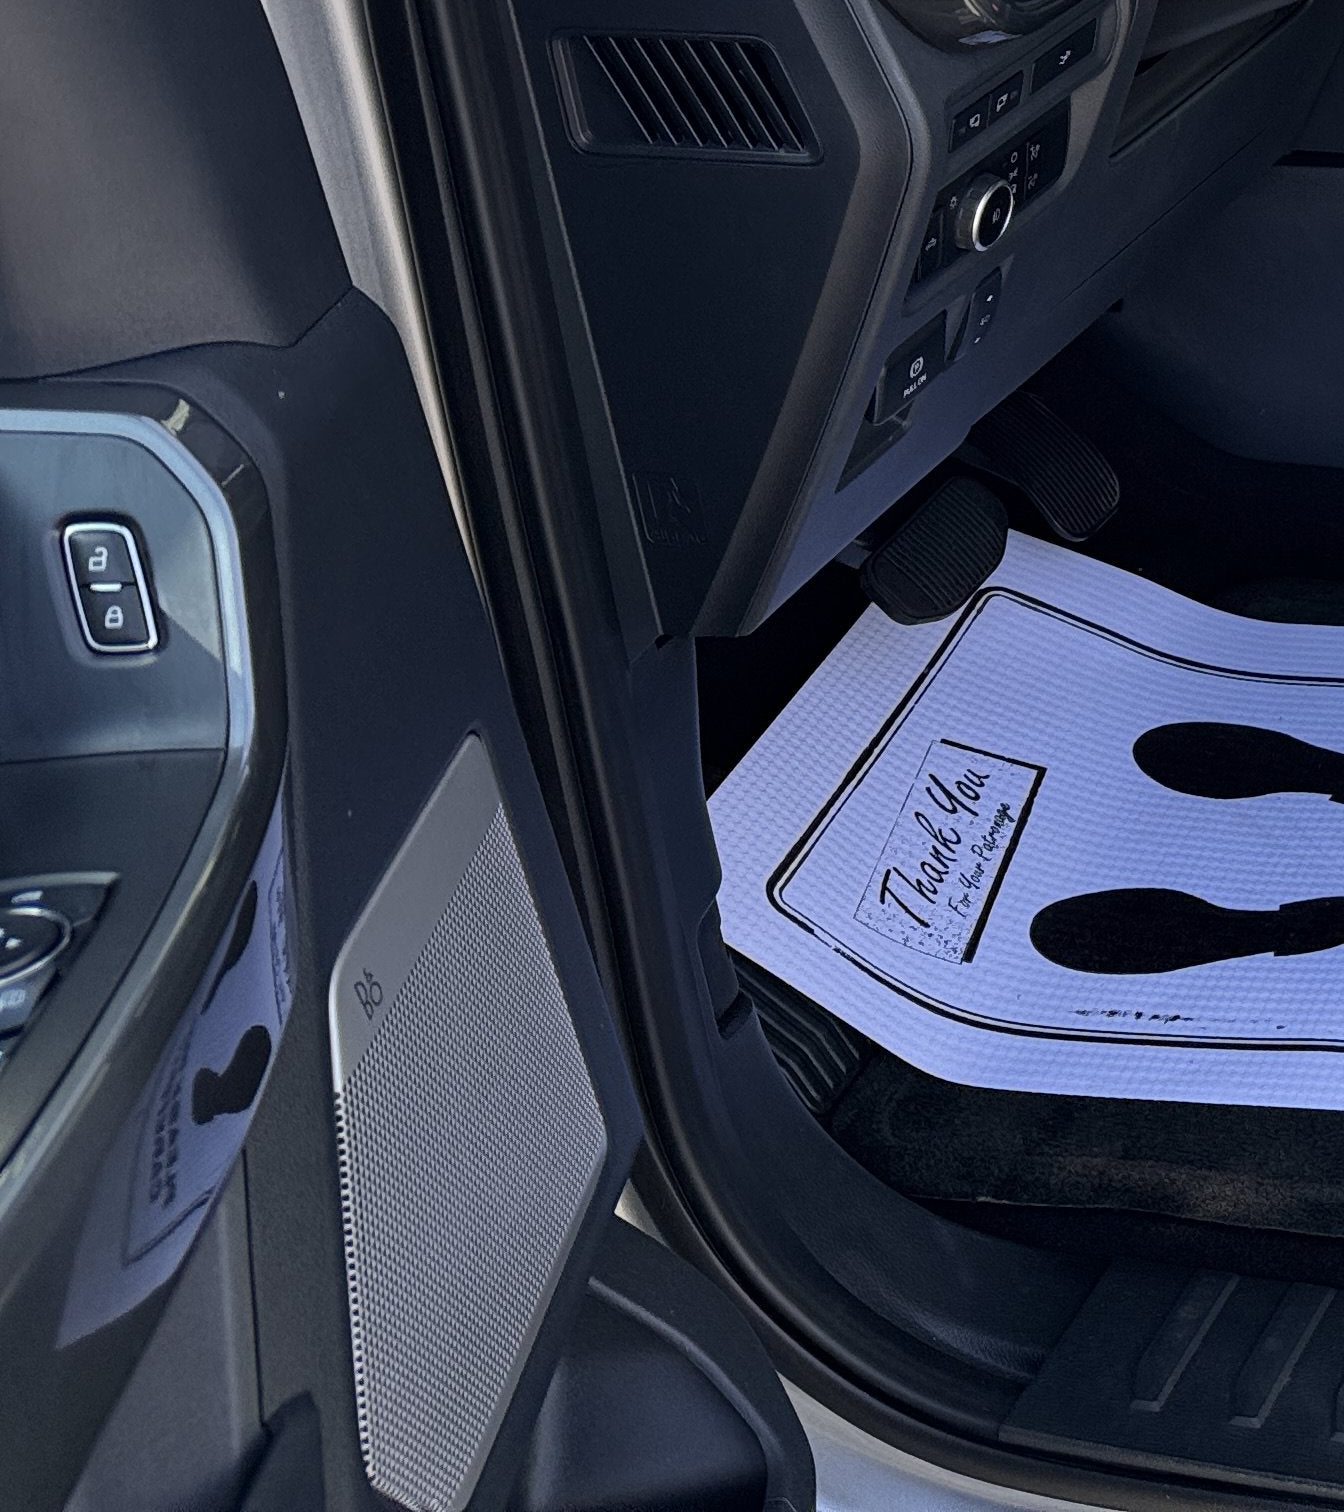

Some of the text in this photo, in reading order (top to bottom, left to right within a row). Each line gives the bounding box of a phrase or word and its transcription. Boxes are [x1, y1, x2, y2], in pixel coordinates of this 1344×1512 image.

[879, 768, 991, 928] Thank You
[948, 802, 1017, 919] For Your Patronage
